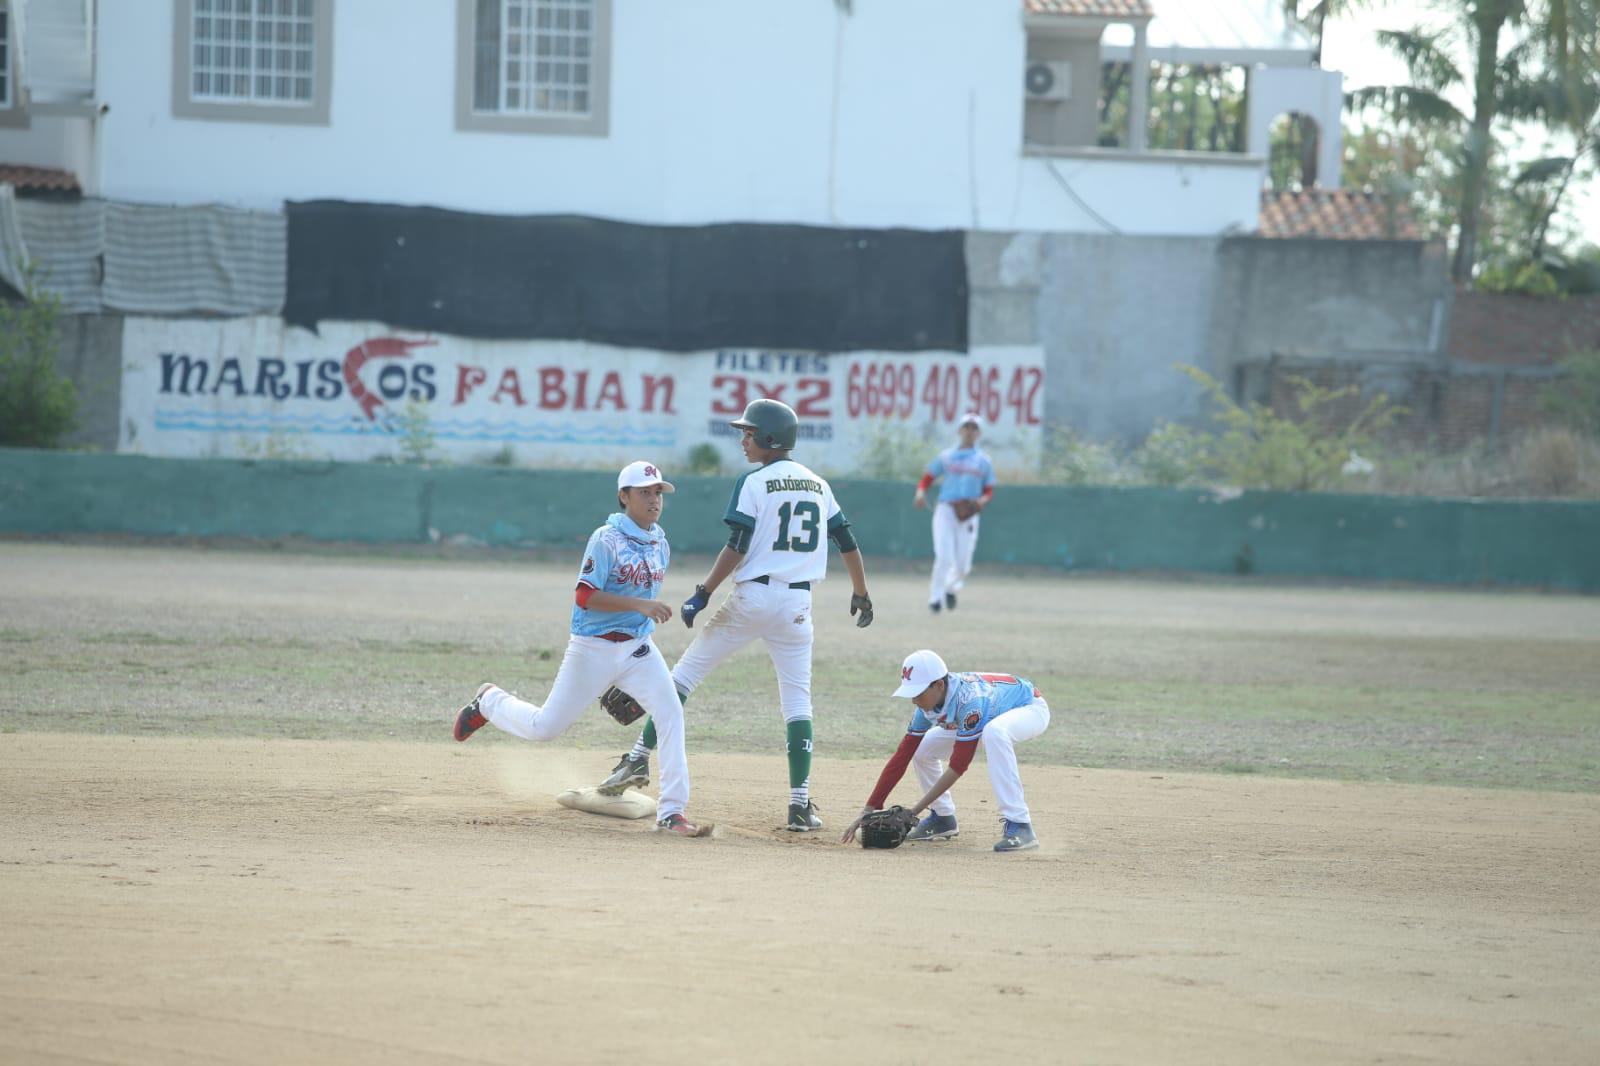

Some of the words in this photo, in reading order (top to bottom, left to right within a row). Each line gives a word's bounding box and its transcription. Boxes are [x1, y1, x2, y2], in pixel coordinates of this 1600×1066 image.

[716, 351, 829, 373] FILETES
[452, 363, 677, 415] FABIAN
[848, 362, 915, 419] 6699
[922, 363, 959, 424] 40
[967, 365, 1000, 424] 96
[1007, 366, 1043, 425] 42
[772, 501, 820, 553] 13
